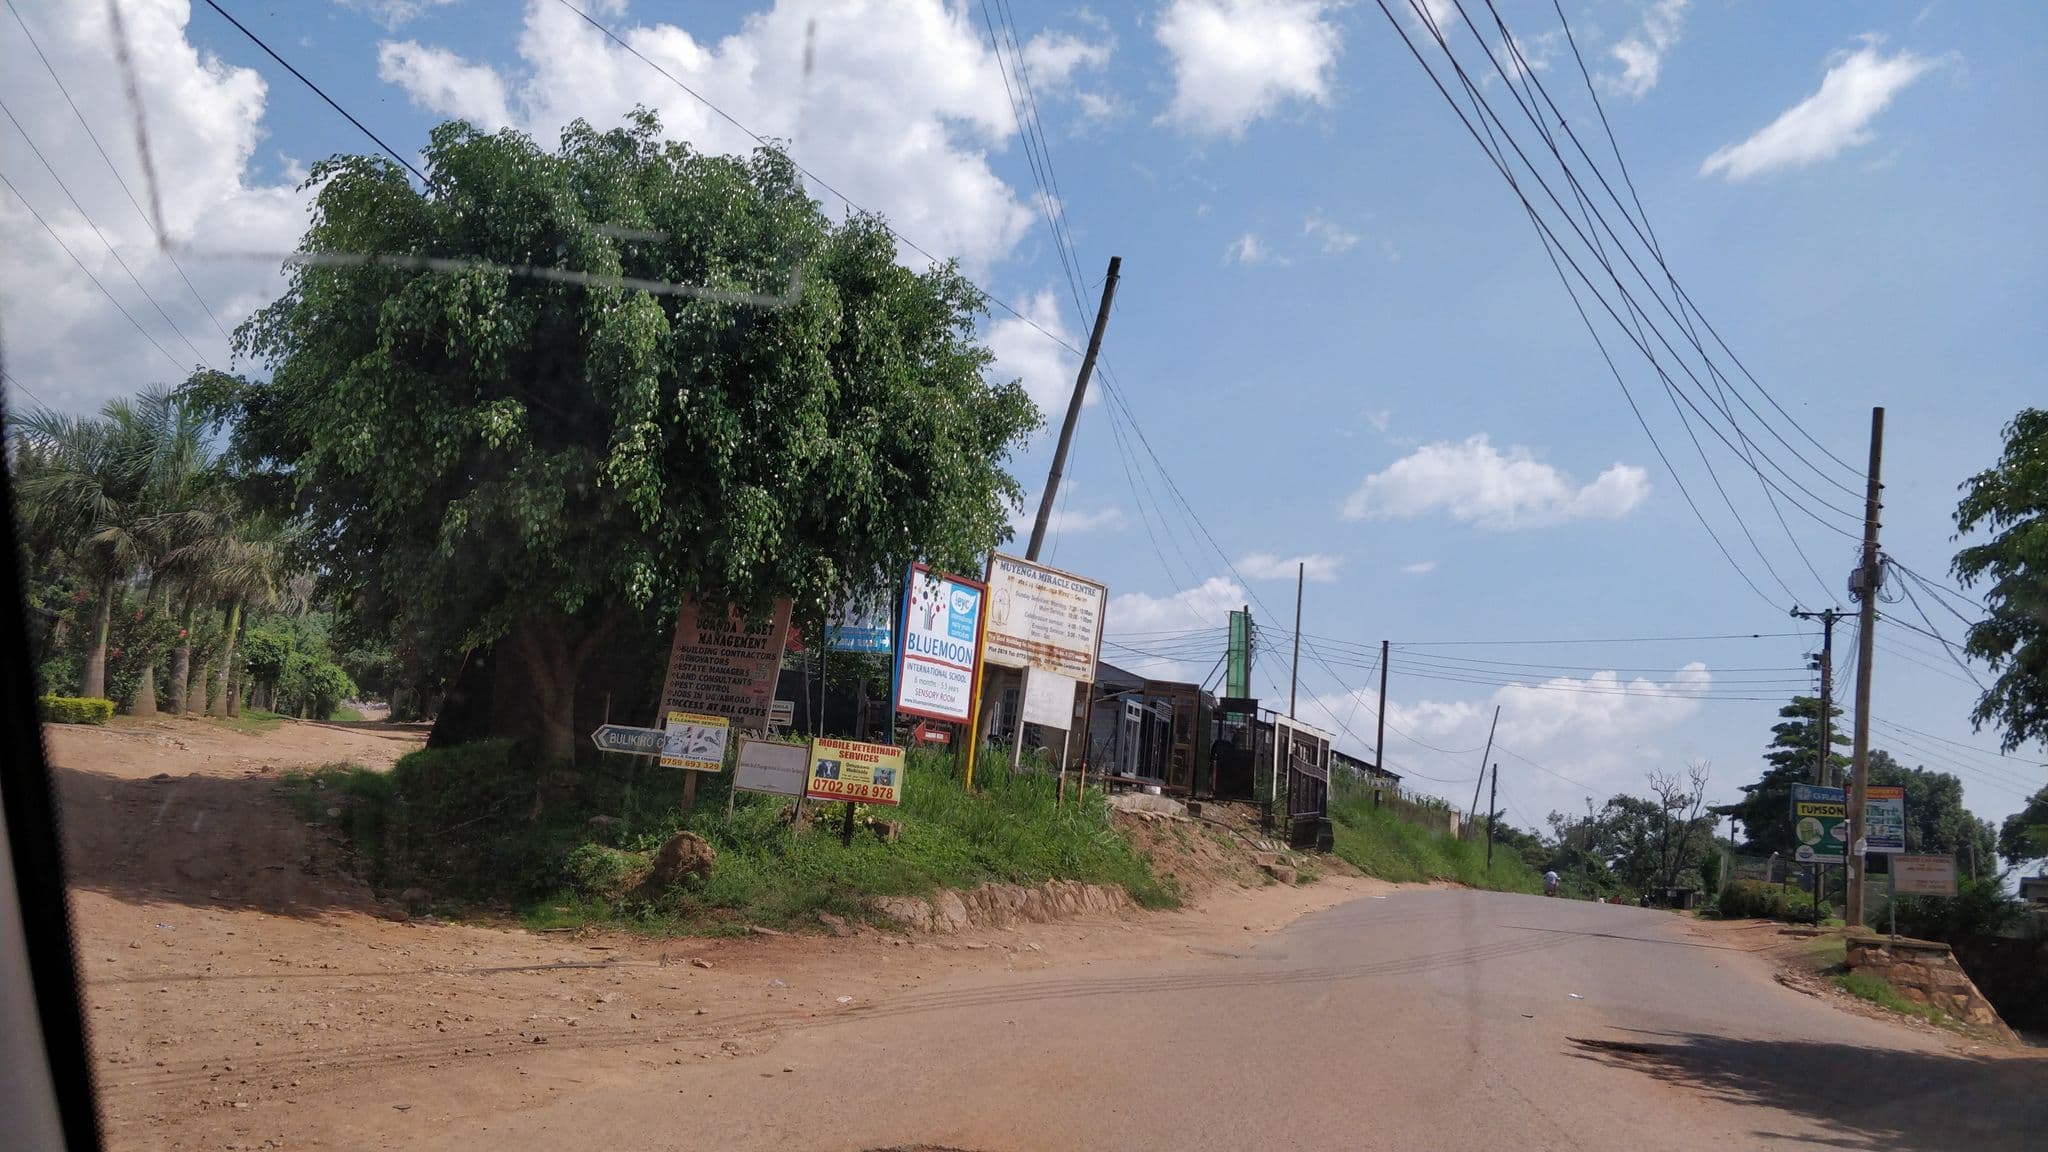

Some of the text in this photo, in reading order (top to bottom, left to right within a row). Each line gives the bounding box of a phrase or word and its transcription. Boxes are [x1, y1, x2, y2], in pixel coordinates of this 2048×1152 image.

[1000, 561, 1036, 580] MUYENGA
[1039, 572, 1069, 589] MIRACLE
[1071, 583, 1096, 597] CENTRE
[744, 620, 775, 636] ASET
[698, 632, 768, 650] MANAGEMENT
[908, 633, 972, 664] BLUEMOON
[680, 654, 730, 666] RENOVATORS
[681, 645, 777, 660] BUILDING CONTRACTORS
[679, 662, 750, 677] ESTATE MANAGERS
[906, 662, 966, 683] INTERNATIONAL SCHOOL
[676, 672, 752, 686] LAND CONSULTANTS
[672, 690, 692, 698] JOBS
[694, 691, 702, 699] IN
[674, 682, 730, 694] PEST CONTROL
[915, 688, 956, 702] SENSORY ROOM
[666, 698, 706, 710] SUCCESS
[706, 702, 718, 712] AT
[720, 704, 735, 714] ALL
[738, 706, 768, 717] COSTS
[818, 738, 900, 758] MOBILE VETERINARY
[839, 750, 879, 763] SERVICES
[814, 778, 894, 800] 0702 978 978
